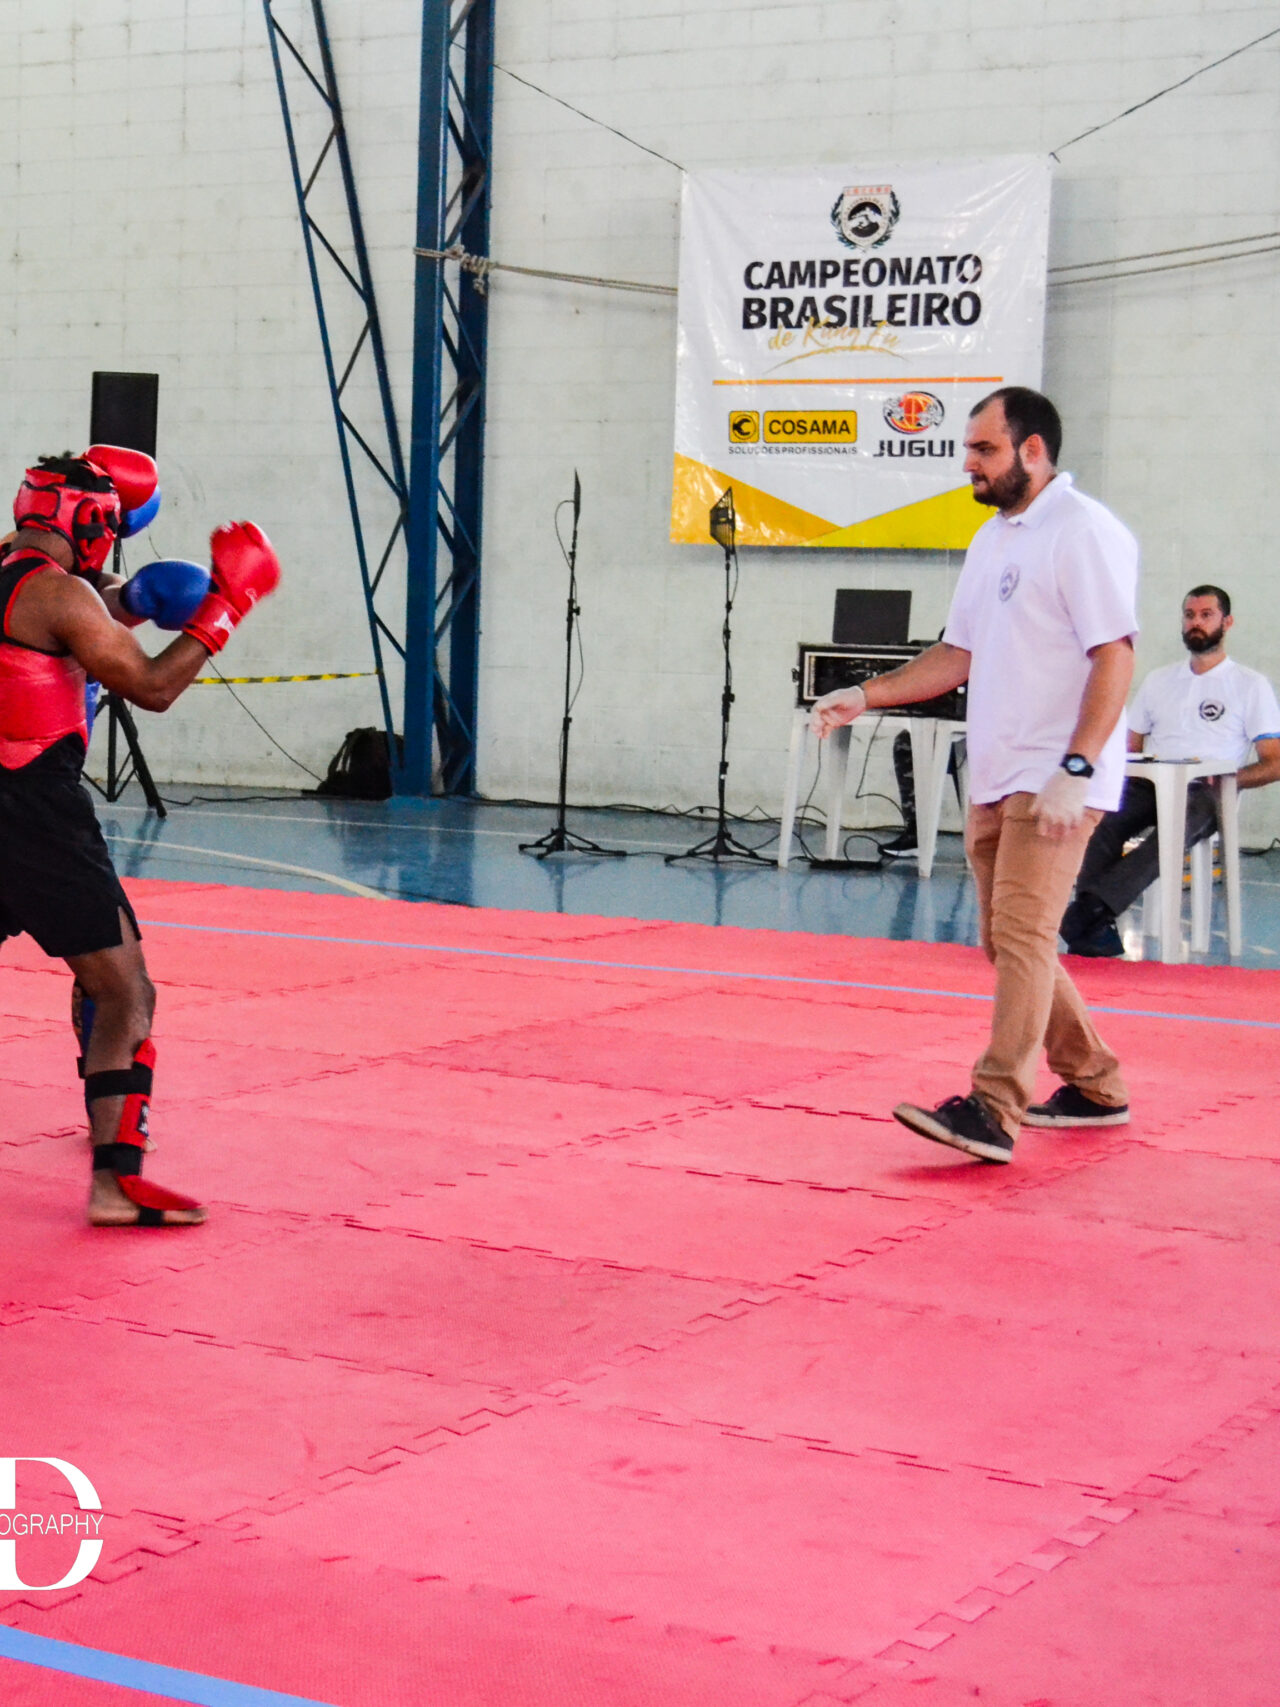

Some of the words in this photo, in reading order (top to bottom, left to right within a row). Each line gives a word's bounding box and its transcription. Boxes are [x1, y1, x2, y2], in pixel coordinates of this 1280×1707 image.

[744, 254, 982, 290] CAMPEONATO
[742, 291, 982, 330] BRASILEIRO
[768, 324, 795, 351] de
[802, 315, 860, 348] Kung
[768, 419, 851, 436] COSAMA
[872, 439, 955, 458] JUGUI
